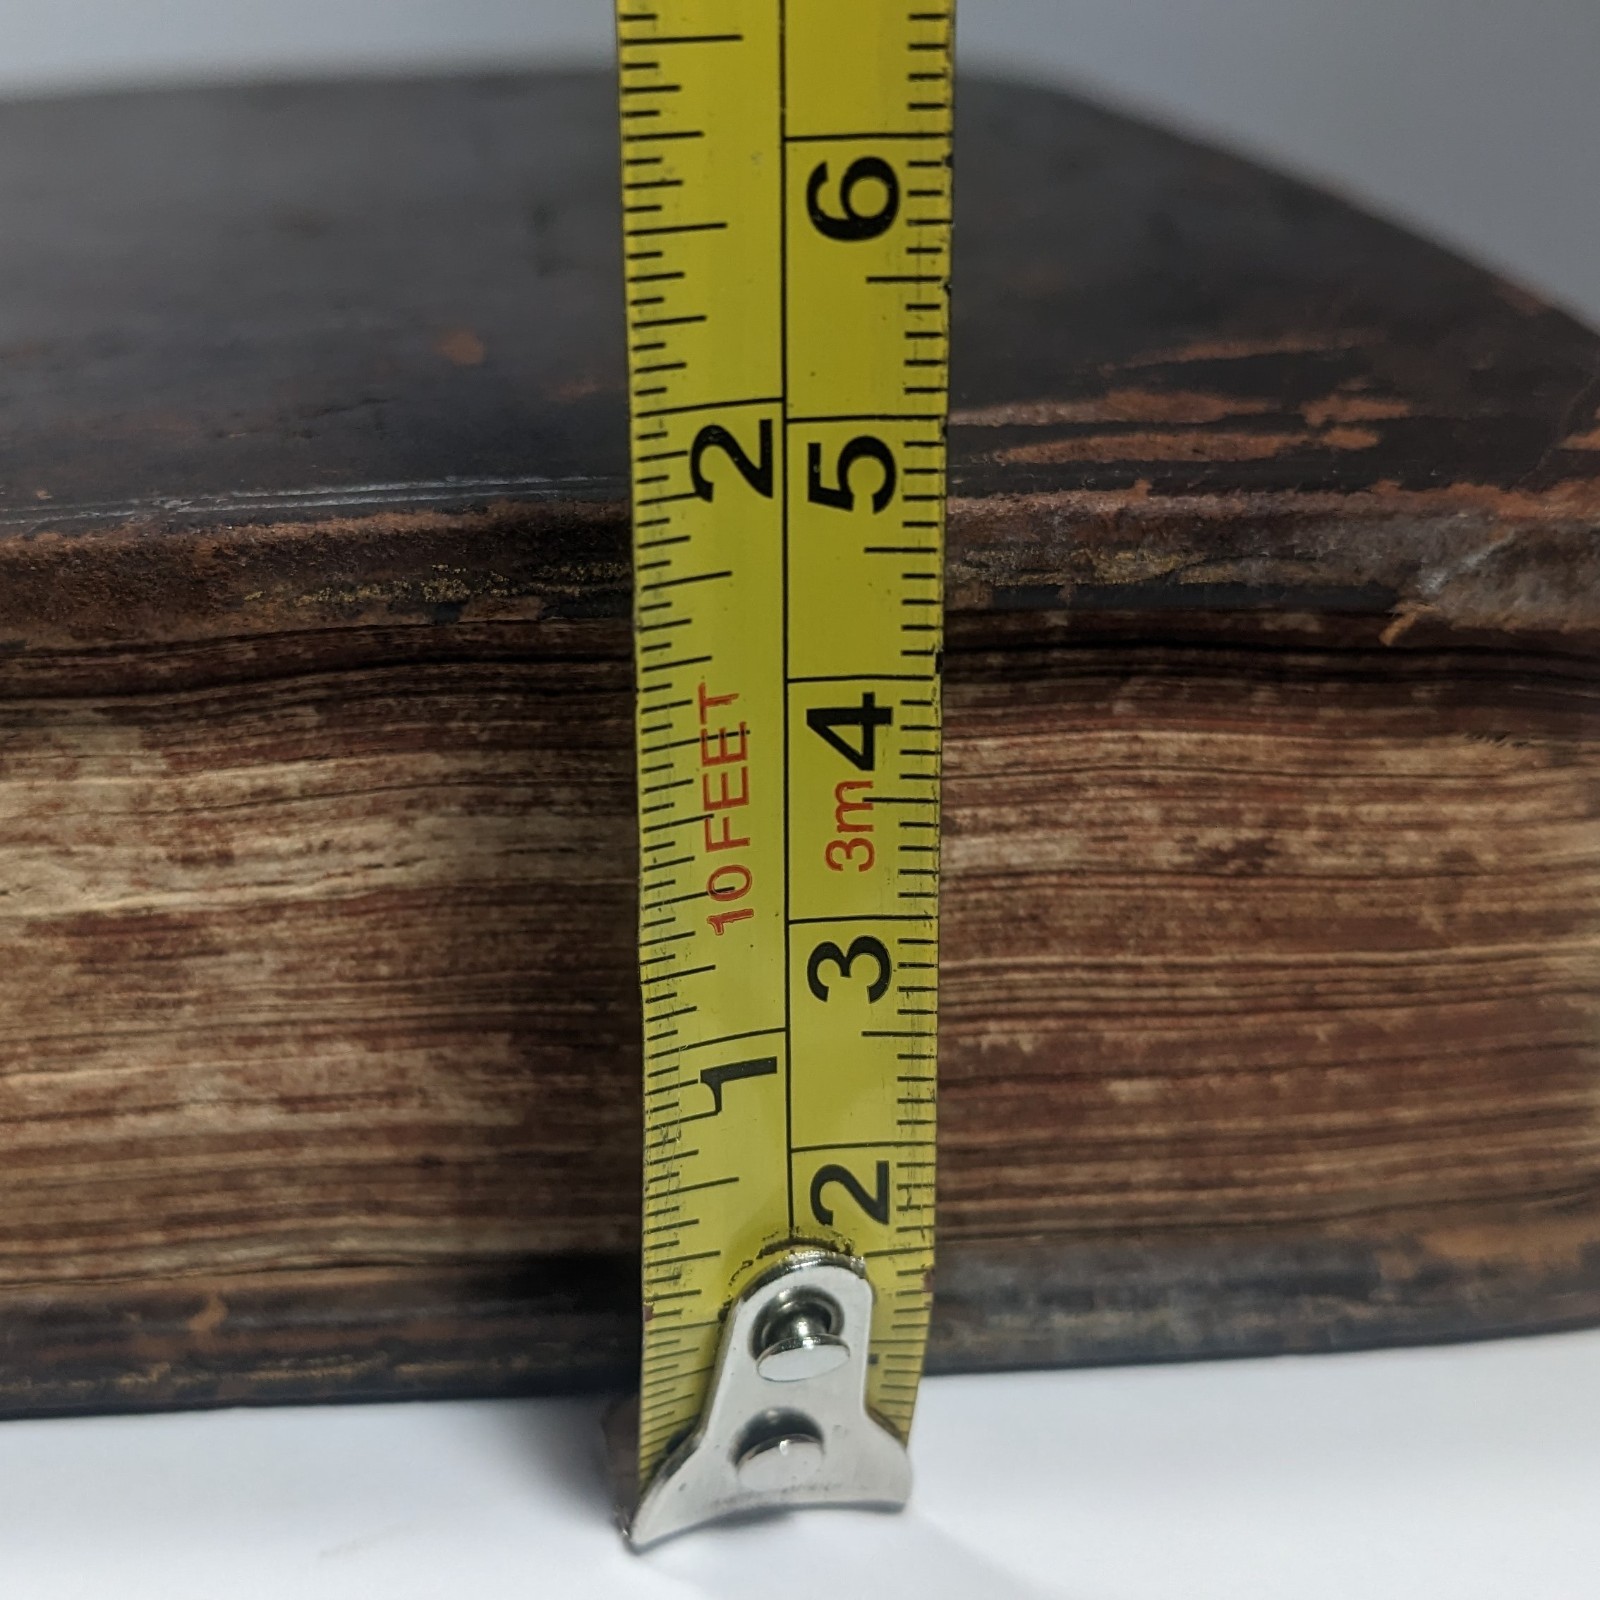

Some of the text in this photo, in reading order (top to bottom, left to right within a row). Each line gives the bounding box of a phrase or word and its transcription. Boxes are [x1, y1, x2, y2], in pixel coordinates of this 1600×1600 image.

[806, 156, 900, 242] 6
[691, 418, 775, 503] 2
[808, 435, 897, 514] 5
[807, 692, 893, 772] 4
[825, 780, 875, 872] 3m
[807, 936, 892, 1003] 3
[700, 1056, 777, 1113] 1
[810, 1161, 889, 1226] 2
